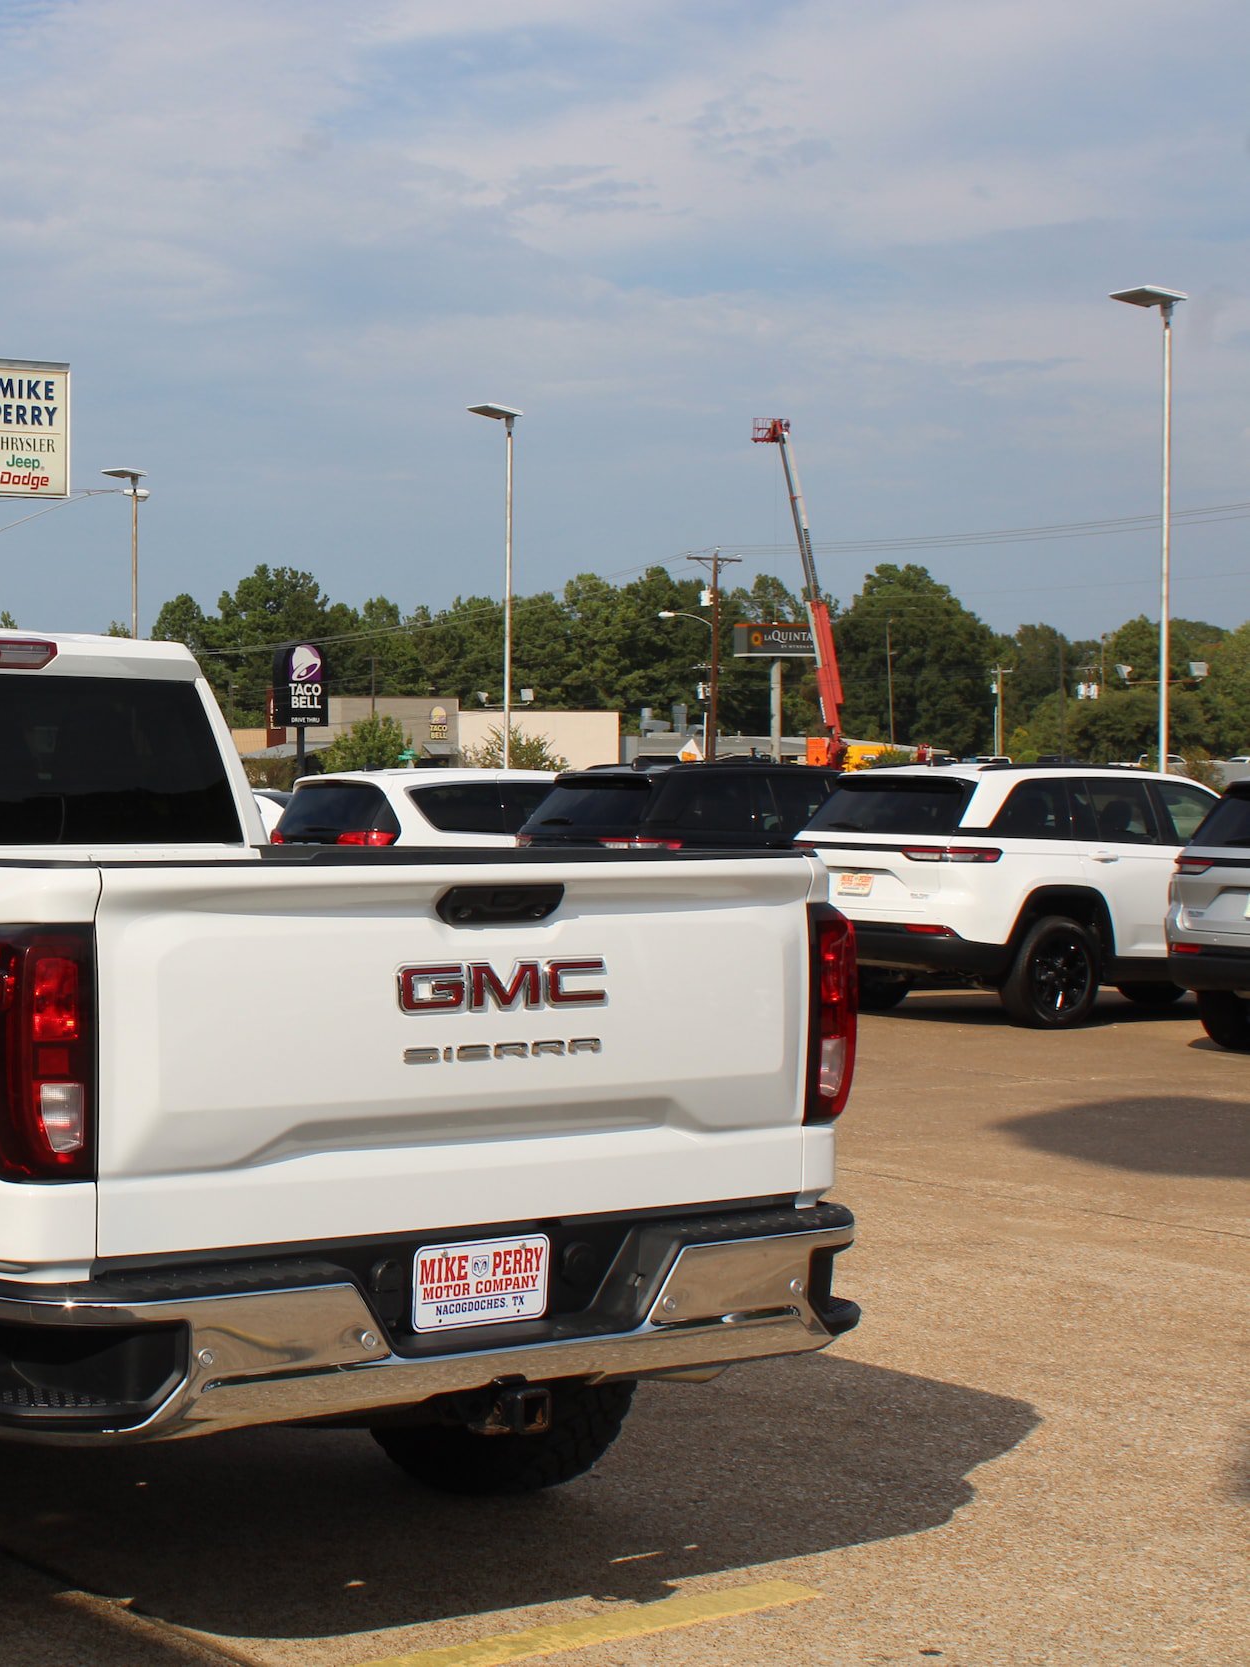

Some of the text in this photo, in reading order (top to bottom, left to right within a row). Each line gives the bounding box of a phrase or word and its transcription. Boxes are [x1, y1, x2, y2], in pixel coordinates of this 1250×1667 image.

[6, 454, 41, 471] Jeep
[0, 471, 50, 490] Dodge
[289, 683, 322, 696] TACO
[291, 696, 322, 709] BELL
[396, 954, 608, 1015] GMC
[403, 1037, 602, 1064] SIERRA
[419, 1246, 544, 1285] MIKE PERRY
[422, 1274, 538, 1300] MOTOR COMPANY
[511, 1295, 525, 1306] TX
